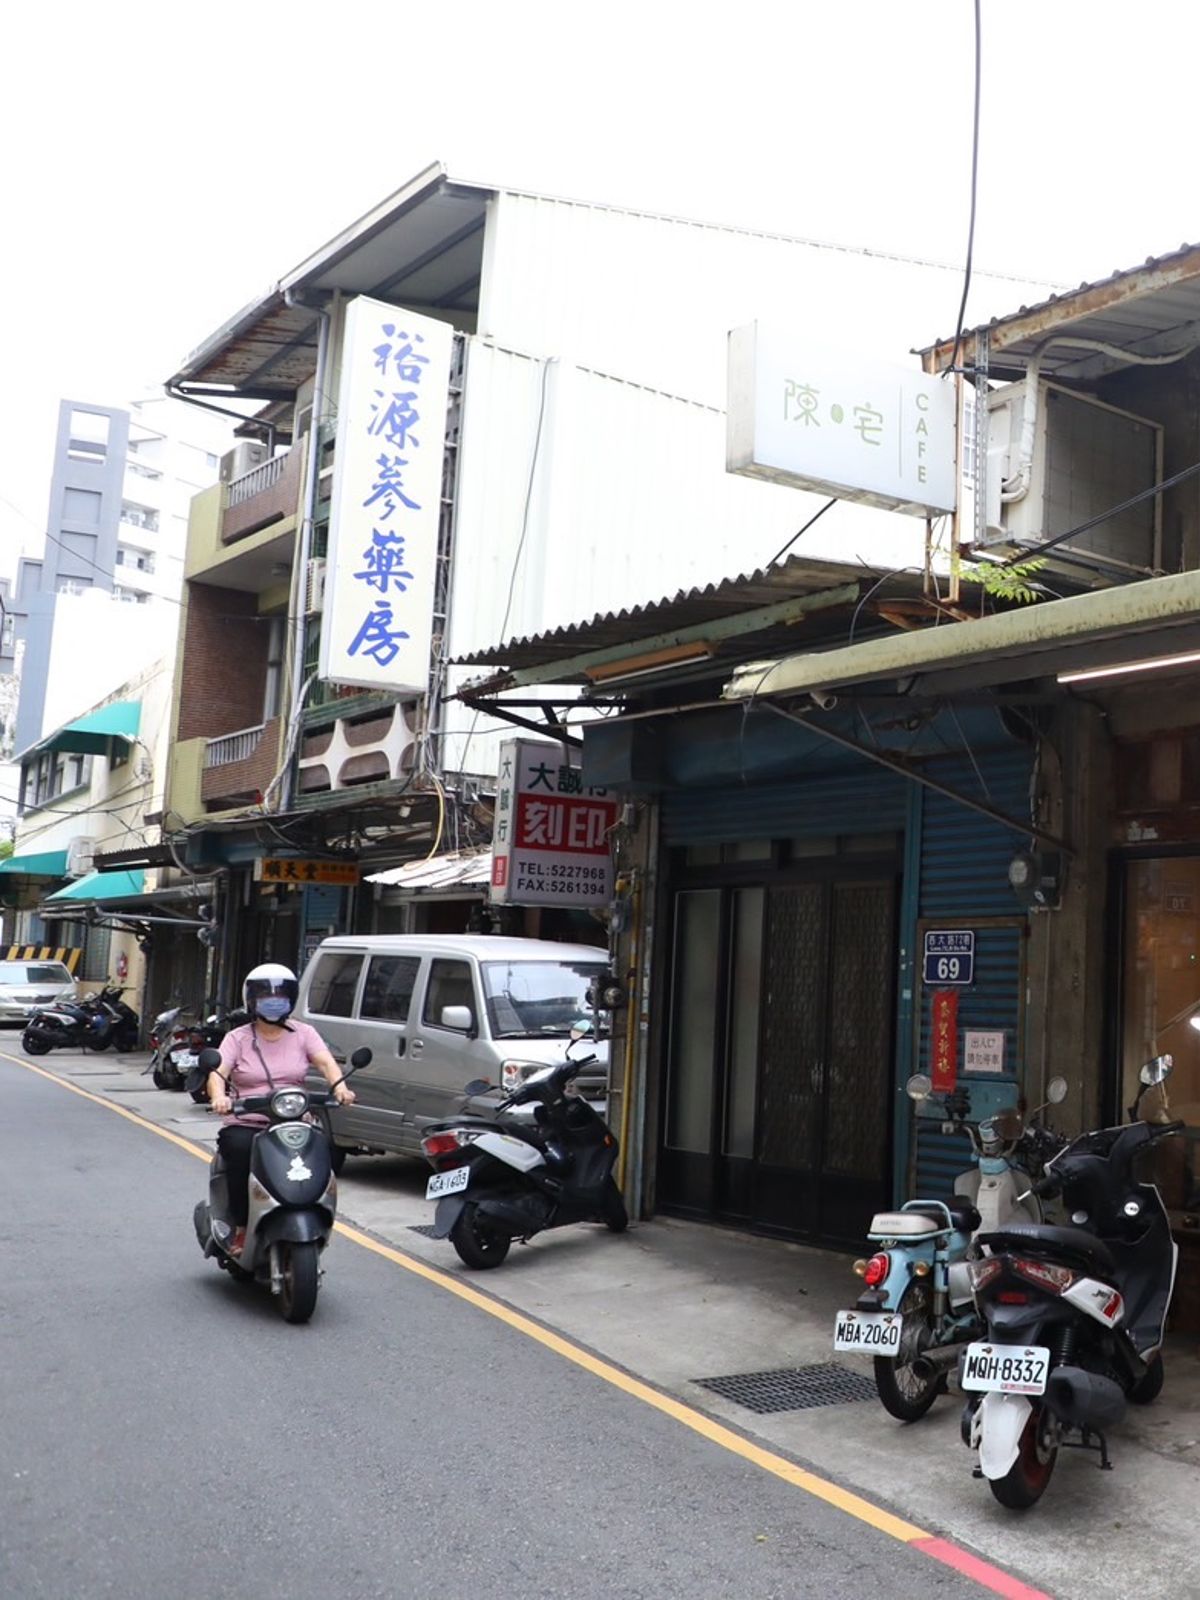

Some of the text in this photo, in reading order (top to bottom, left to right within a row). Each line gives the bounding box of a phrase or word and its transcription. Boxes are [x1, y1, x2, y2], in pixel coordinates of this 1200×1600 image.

[915, 393, 929, 484] CAFE
[523, 801, 607, 849] 刻印
[938, 957, 960, 979] 69
